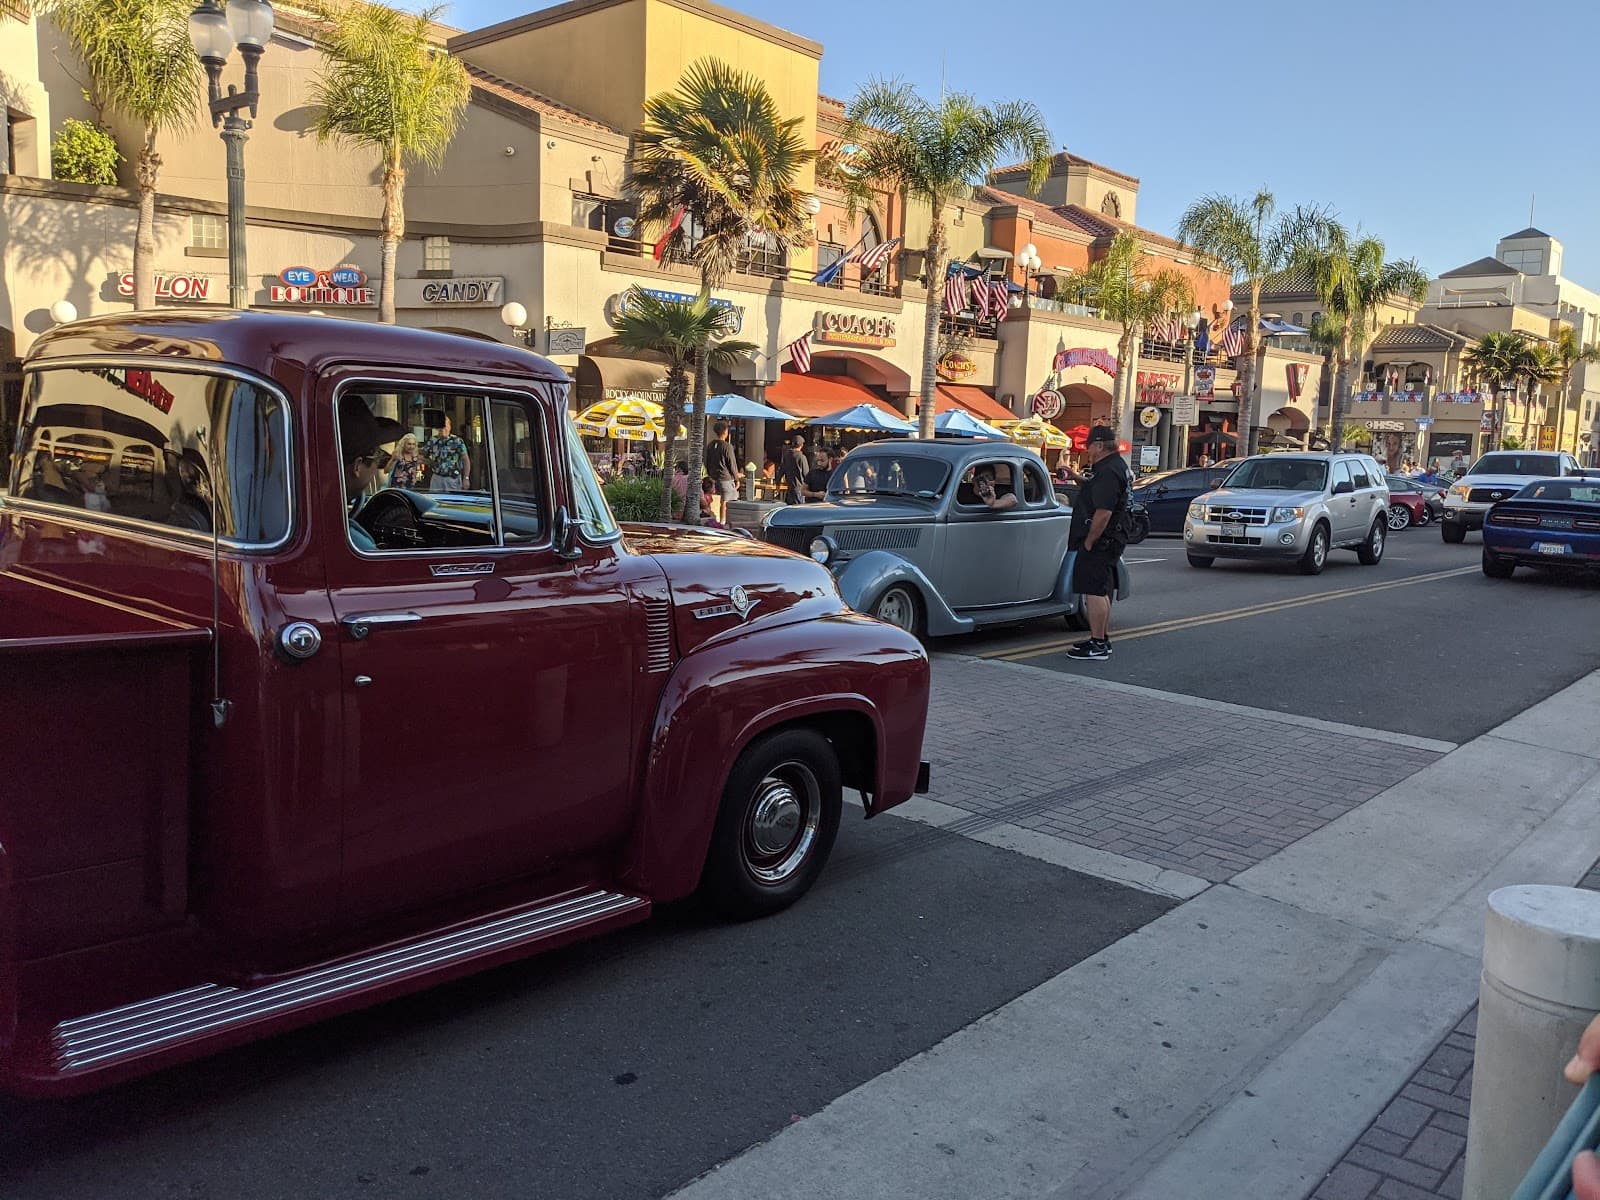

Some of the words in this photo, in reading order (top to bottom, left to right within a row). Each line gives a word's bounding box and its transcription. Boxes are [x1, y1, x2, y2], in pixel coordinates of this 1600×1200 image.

[119, 273, 209, 298] SLON
[287, 270, 311, 282] EYE
[318, 274, 329, 288] &
[332, 272, 360, 284] WEAR
[271, 286, 376, 305] BOUTIQUE
[422, 281, 500, 302] CANDY
[825, 311, 897, 338] COACH'S
[605, 388, 629, 401] ROCKY
